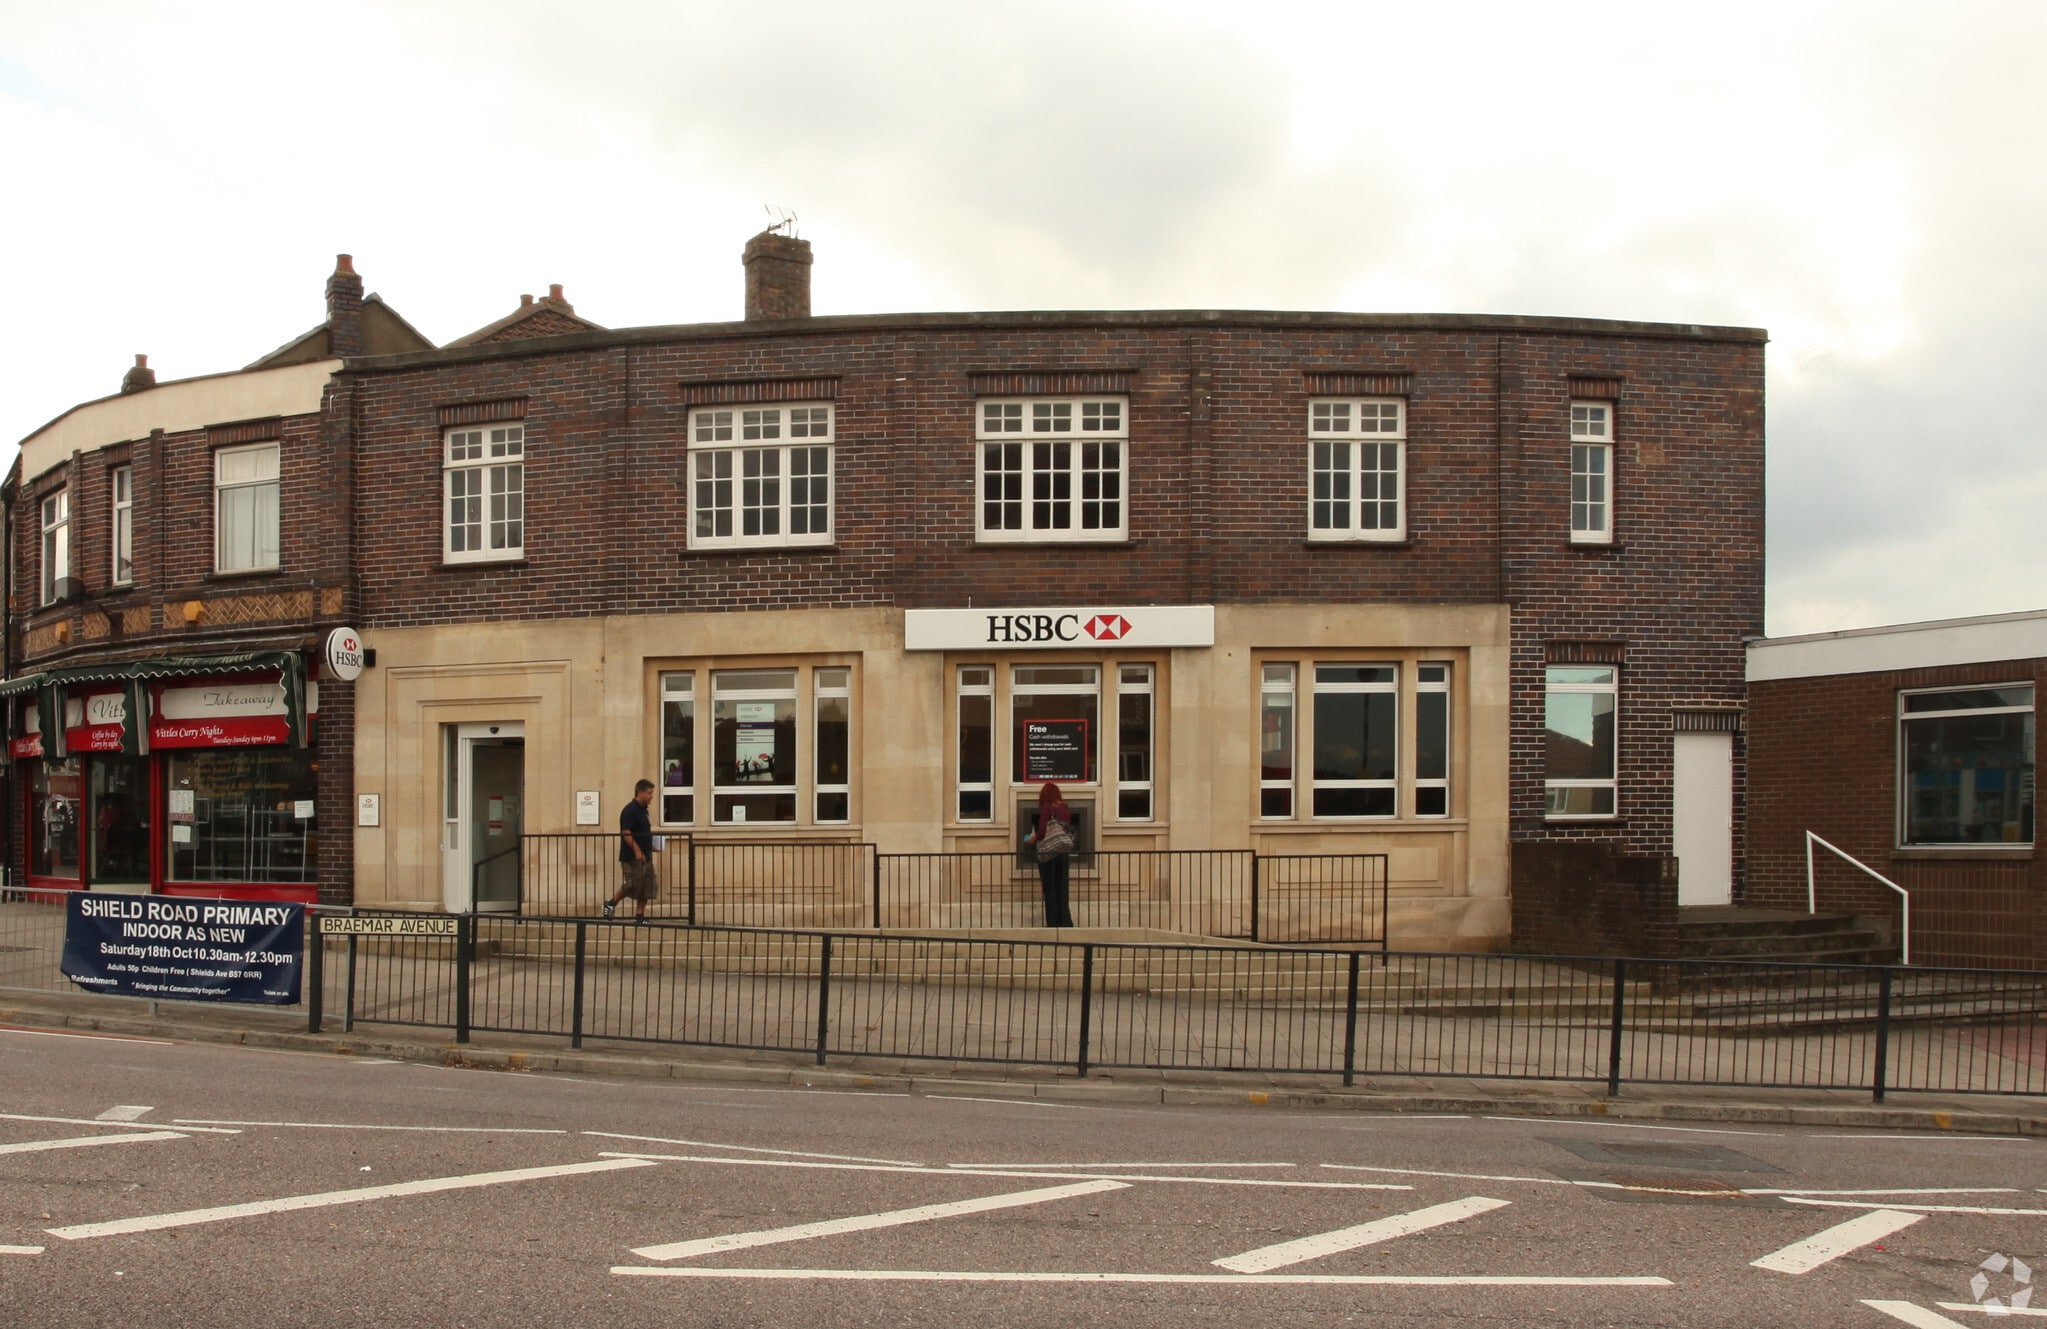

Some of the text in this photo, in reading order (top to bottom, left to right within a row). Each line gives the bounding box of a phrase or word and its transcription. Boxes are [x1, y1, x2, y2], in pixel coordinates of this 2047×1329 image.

[986, 614, 1079, 642] HSBC
[336, 651, 362, 668] HSBC
[204, 692, 275, 709] Takeaway
[155, 725, 223, 739] Vittles Curry Nights
[81, 899, 290, 926] SHIELD ROAD PRIMARY
[123, 922, 245, 943] INDOOR AS NEW
[324, 919, 454, 933] BRAEMAR AVENUE
[100, 942, 146, 959] Saturday
[147, 945, 170, 958] 18th
[172, 946, 192, 959] Oct
[107, 963, 126, 972] Adults
[127, 964, 139, 973] 50p
[141, 965, 169, 974] Children
[170, 967, 185, 975] Free
[215, 969, 228, 977] Ave
[229, 970, 242, 978] BS7
[71, 974, 118, 986] Refreshments
[169, 985, 201, 995] Community
